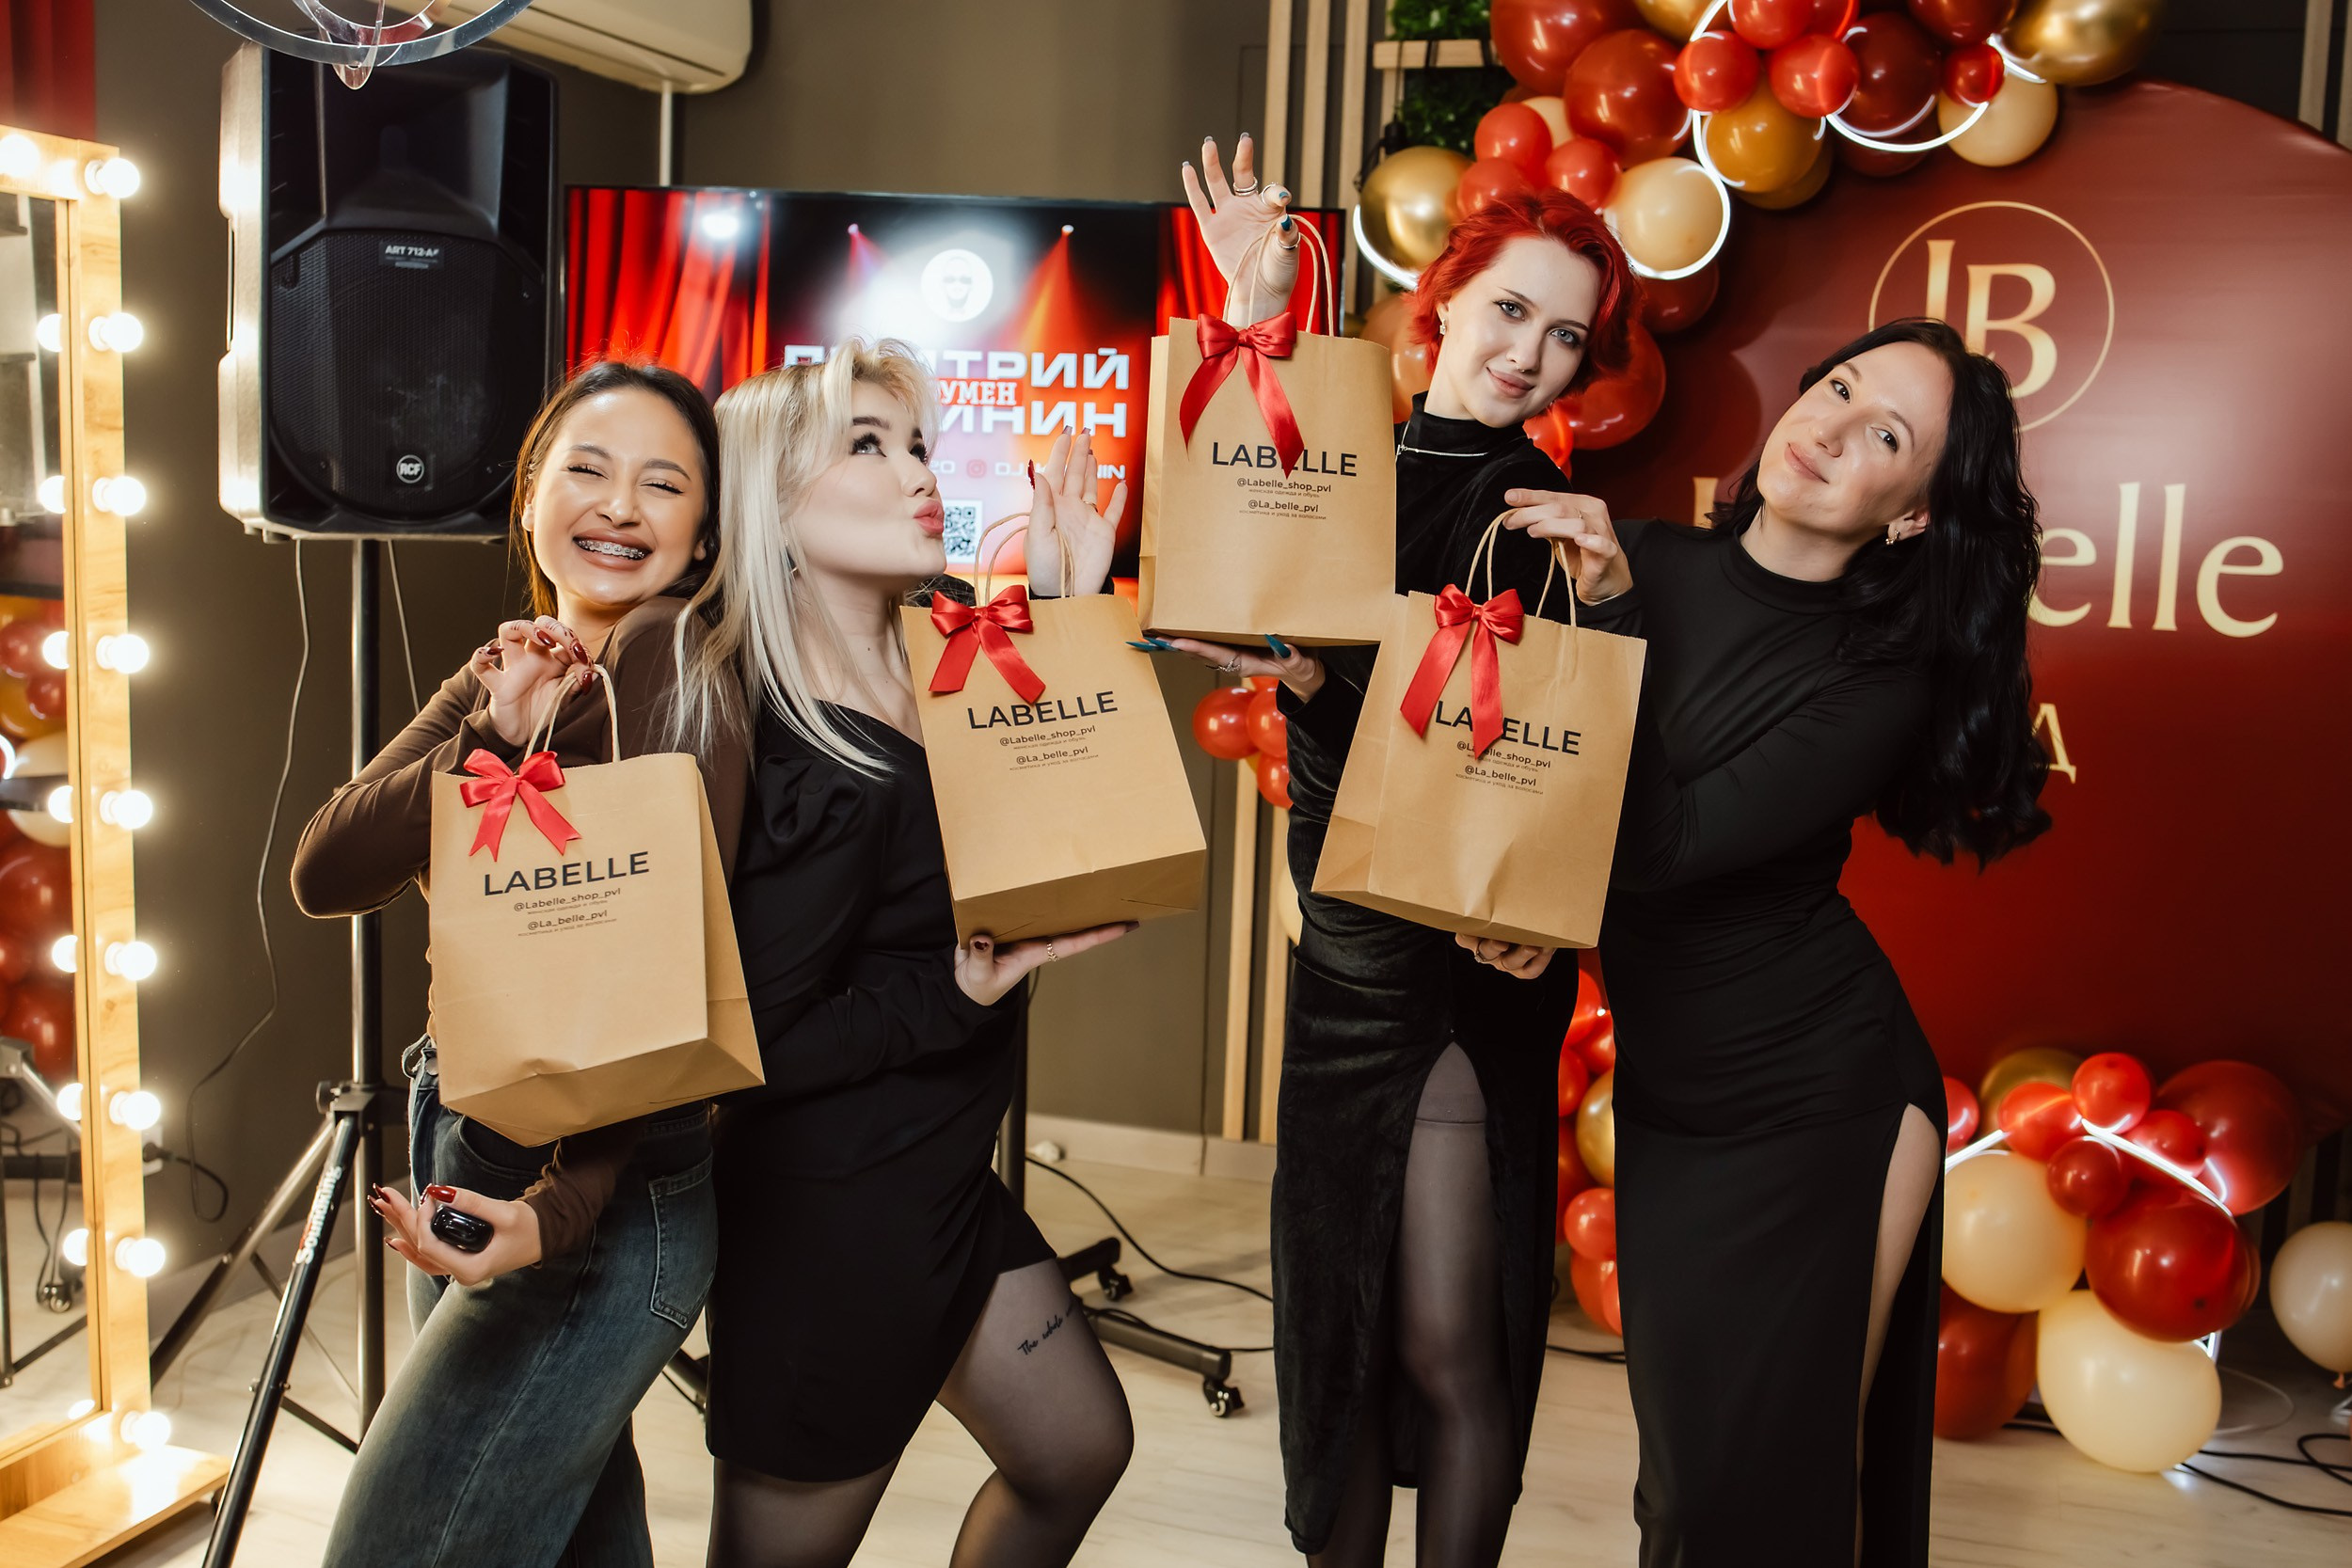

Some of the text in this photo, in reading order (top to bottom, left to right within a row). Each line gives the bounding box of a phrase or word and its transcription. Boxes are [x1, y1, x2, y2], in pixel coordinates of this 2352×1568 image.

[385, 245, 405, 255] ART
[939, 379, 1017, 405] УМЕН
[400, 462, 421, 476] RCF
[1212, 441, 1358, 477] LABLLE
[1236, 477, 1332, 493] @Labelle_shop_pvl
[1248, 499, 1319, 514] @La_belle_pvl
[967, 690, 1119, 730] LABELLE
[999, 724, 1096, 747] @Labelle_shop_pvl
[1435, 700, 1581, 756] LAELLE
[1015, 746, 1089, 766] @La_belle_pvl
[1464, 765, 1536, 787] @La_belle_pvl
[484, 850, 650, 896] LABELLE
[514, 887, 621, 912] @Labelle_shop_pvl
[527, 910, 608, 931] @La_belle_pvl
[1017, 1338, 1039, 1355] The
